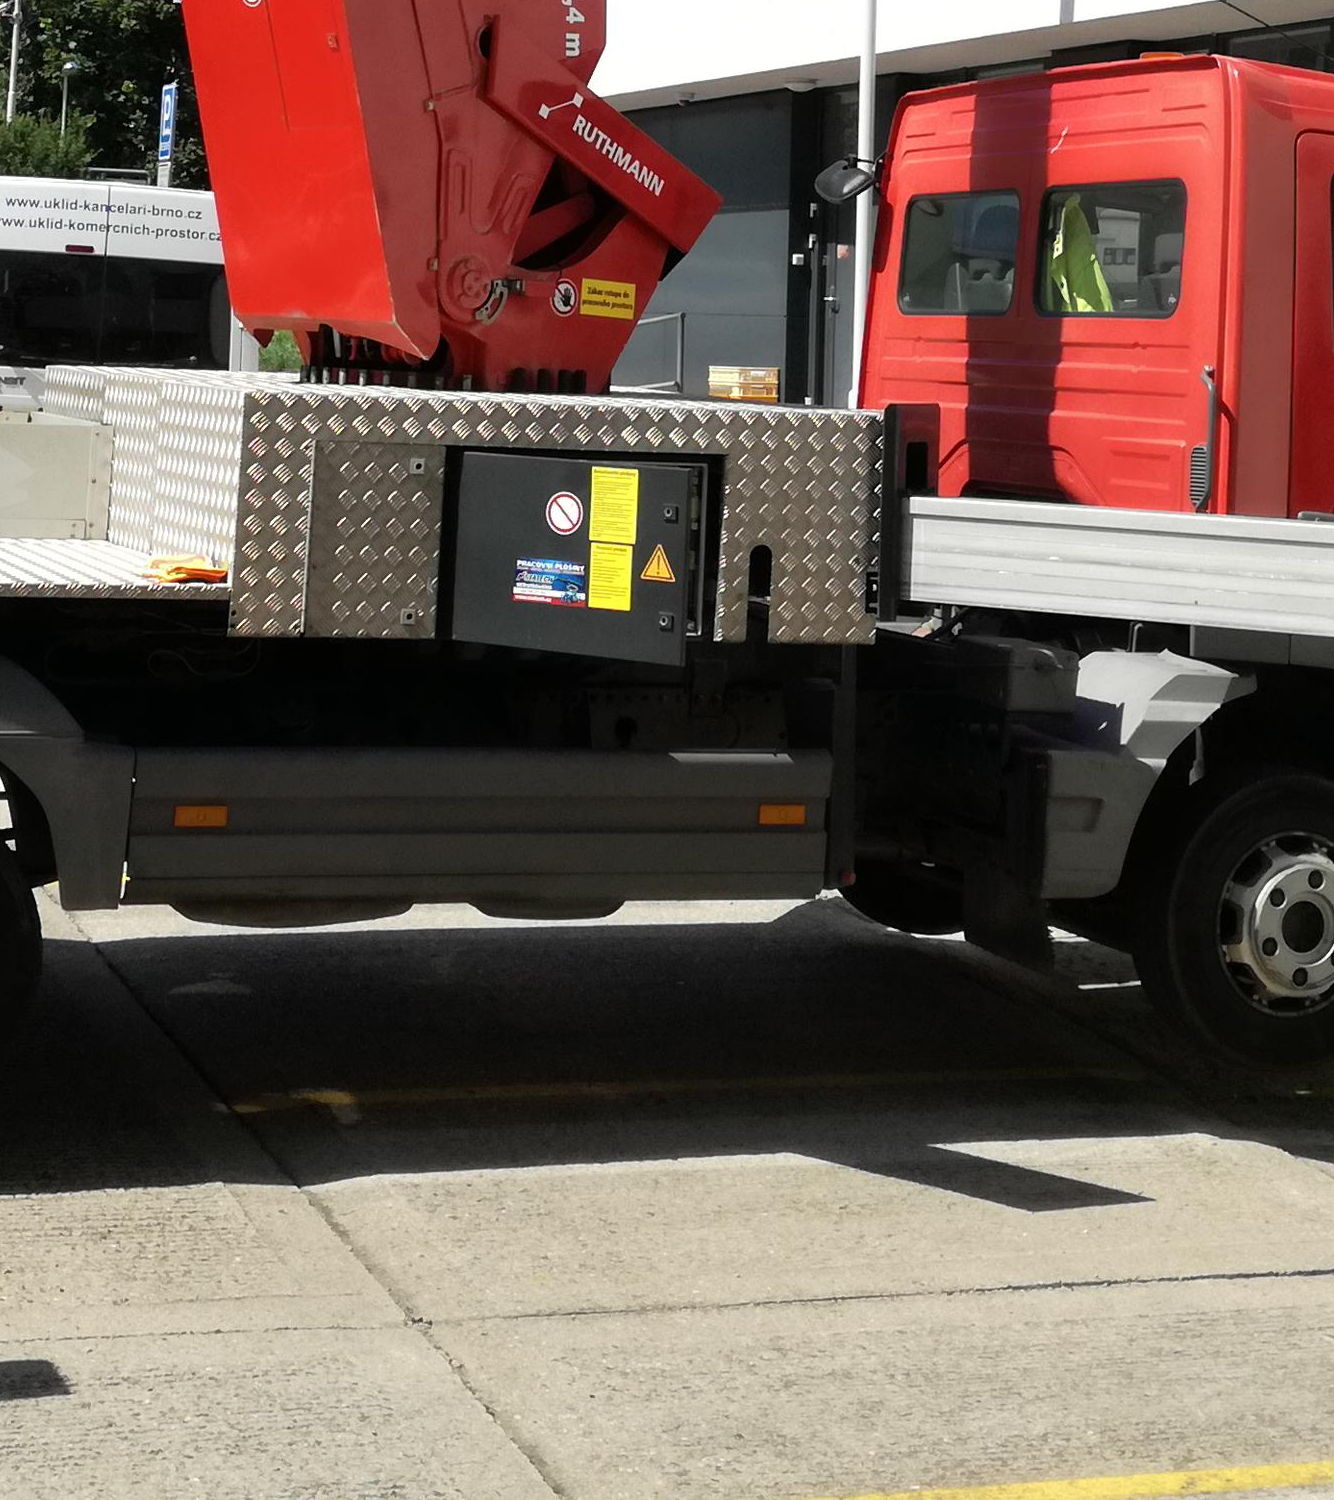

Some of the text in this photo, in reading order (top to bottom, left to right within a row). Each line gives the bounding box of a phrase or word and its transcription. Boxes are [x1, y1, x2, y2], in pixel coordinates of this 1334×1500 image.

[565, 33, 580, 57] m
[572, 114, 665, 196] RUTHMANN
[5, 196, 203, 220] www.uklid-kancelari-brno.cz
